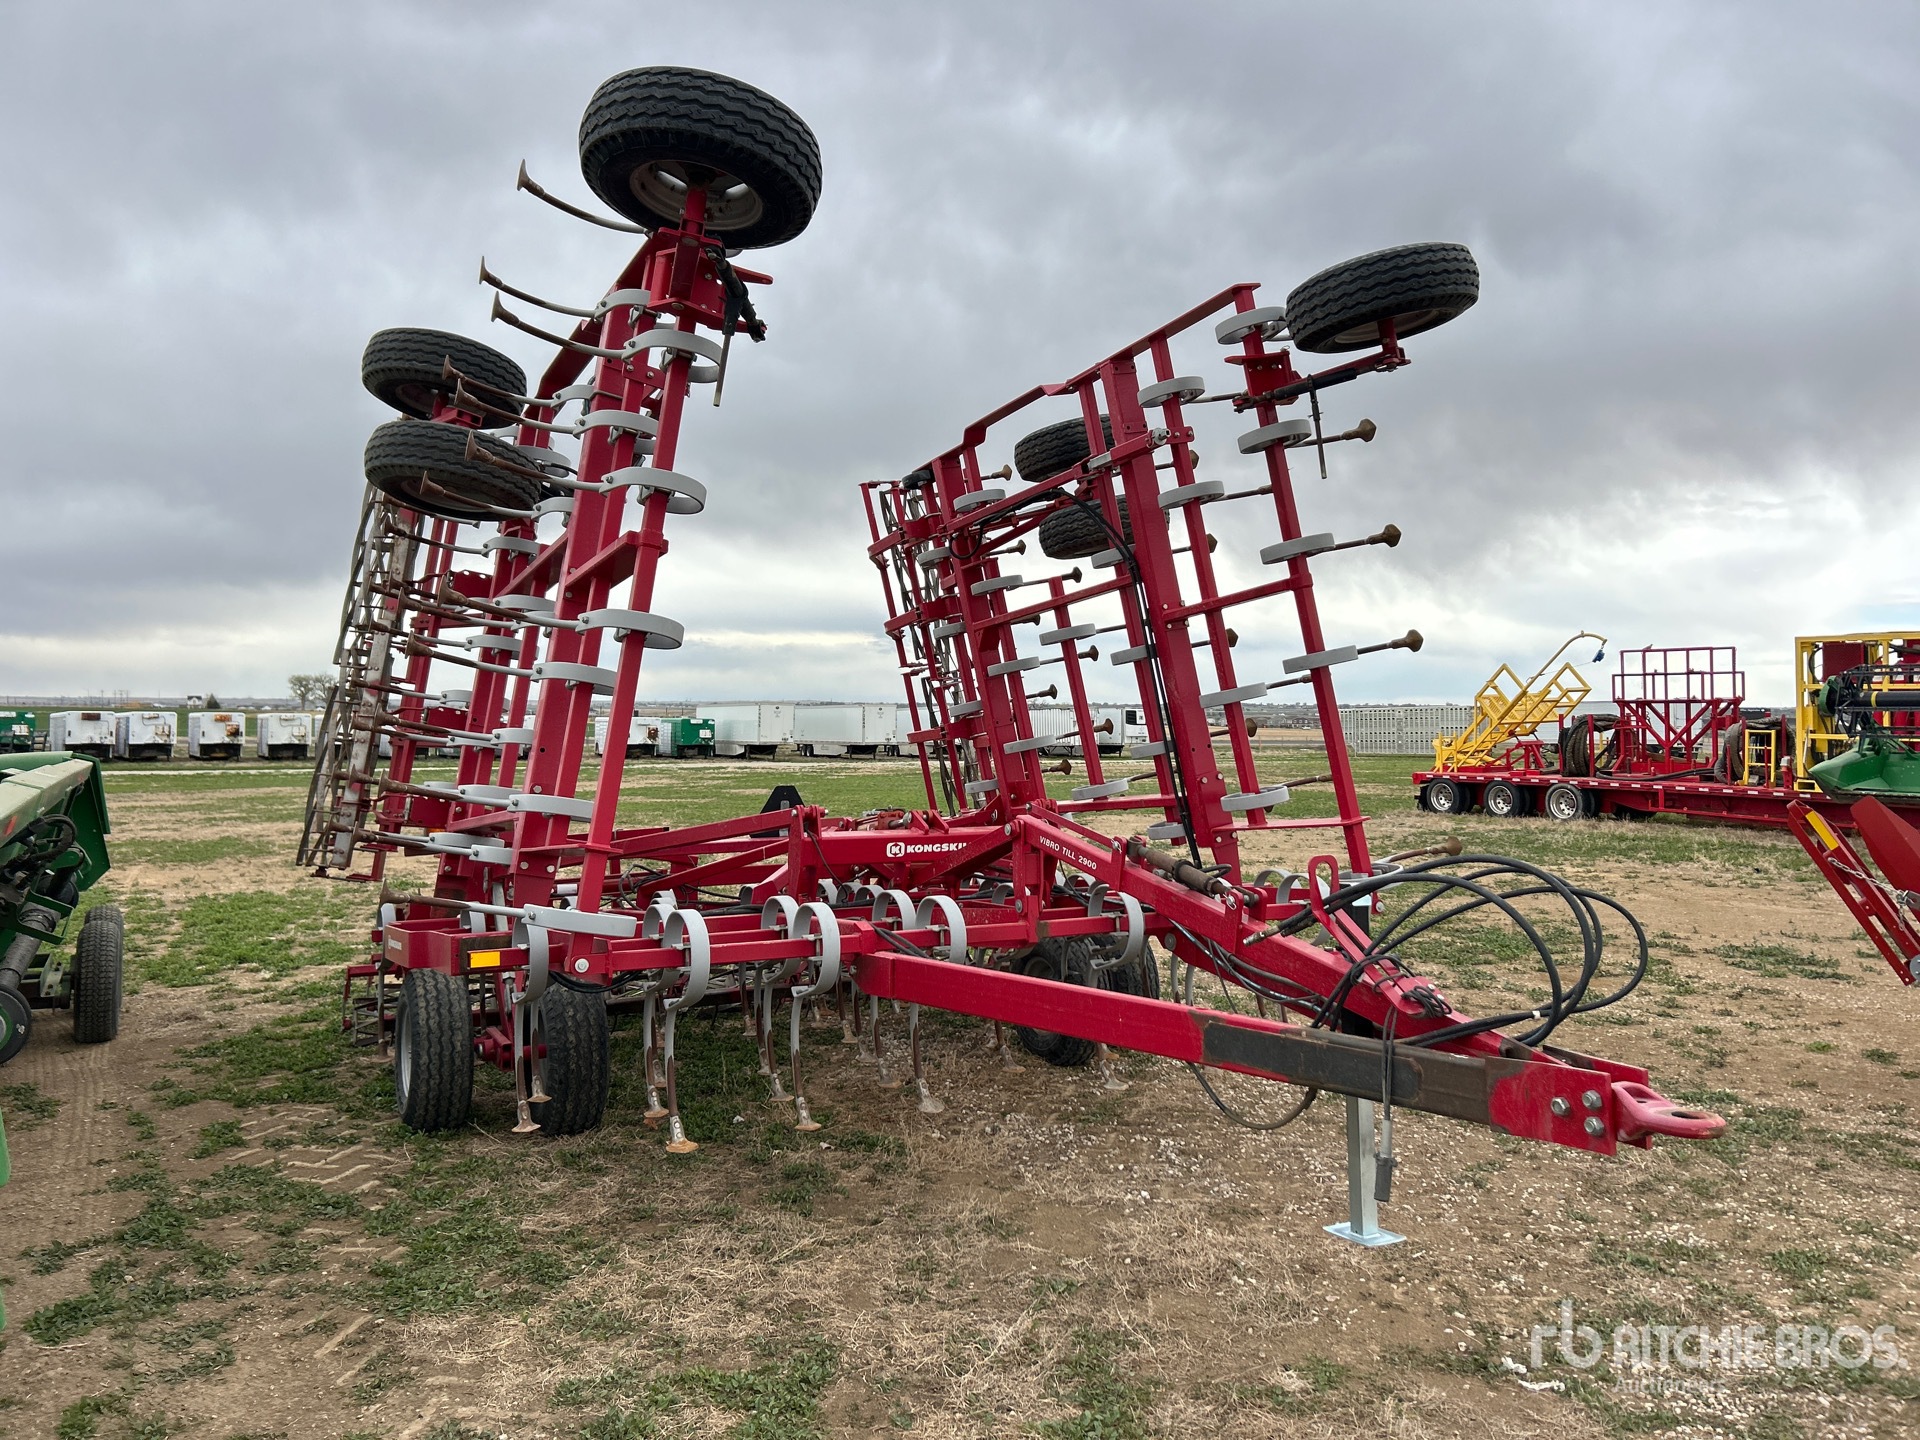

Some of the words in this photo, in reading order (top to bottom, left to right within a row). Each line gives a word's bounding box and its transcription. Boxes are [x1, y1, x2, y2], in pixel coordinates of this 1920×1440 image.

[1040, 836, 1060, 851] VIBRO
[1062, 847, 1076, 860] TILL
[1078, 855, 1097, 870] 2900
